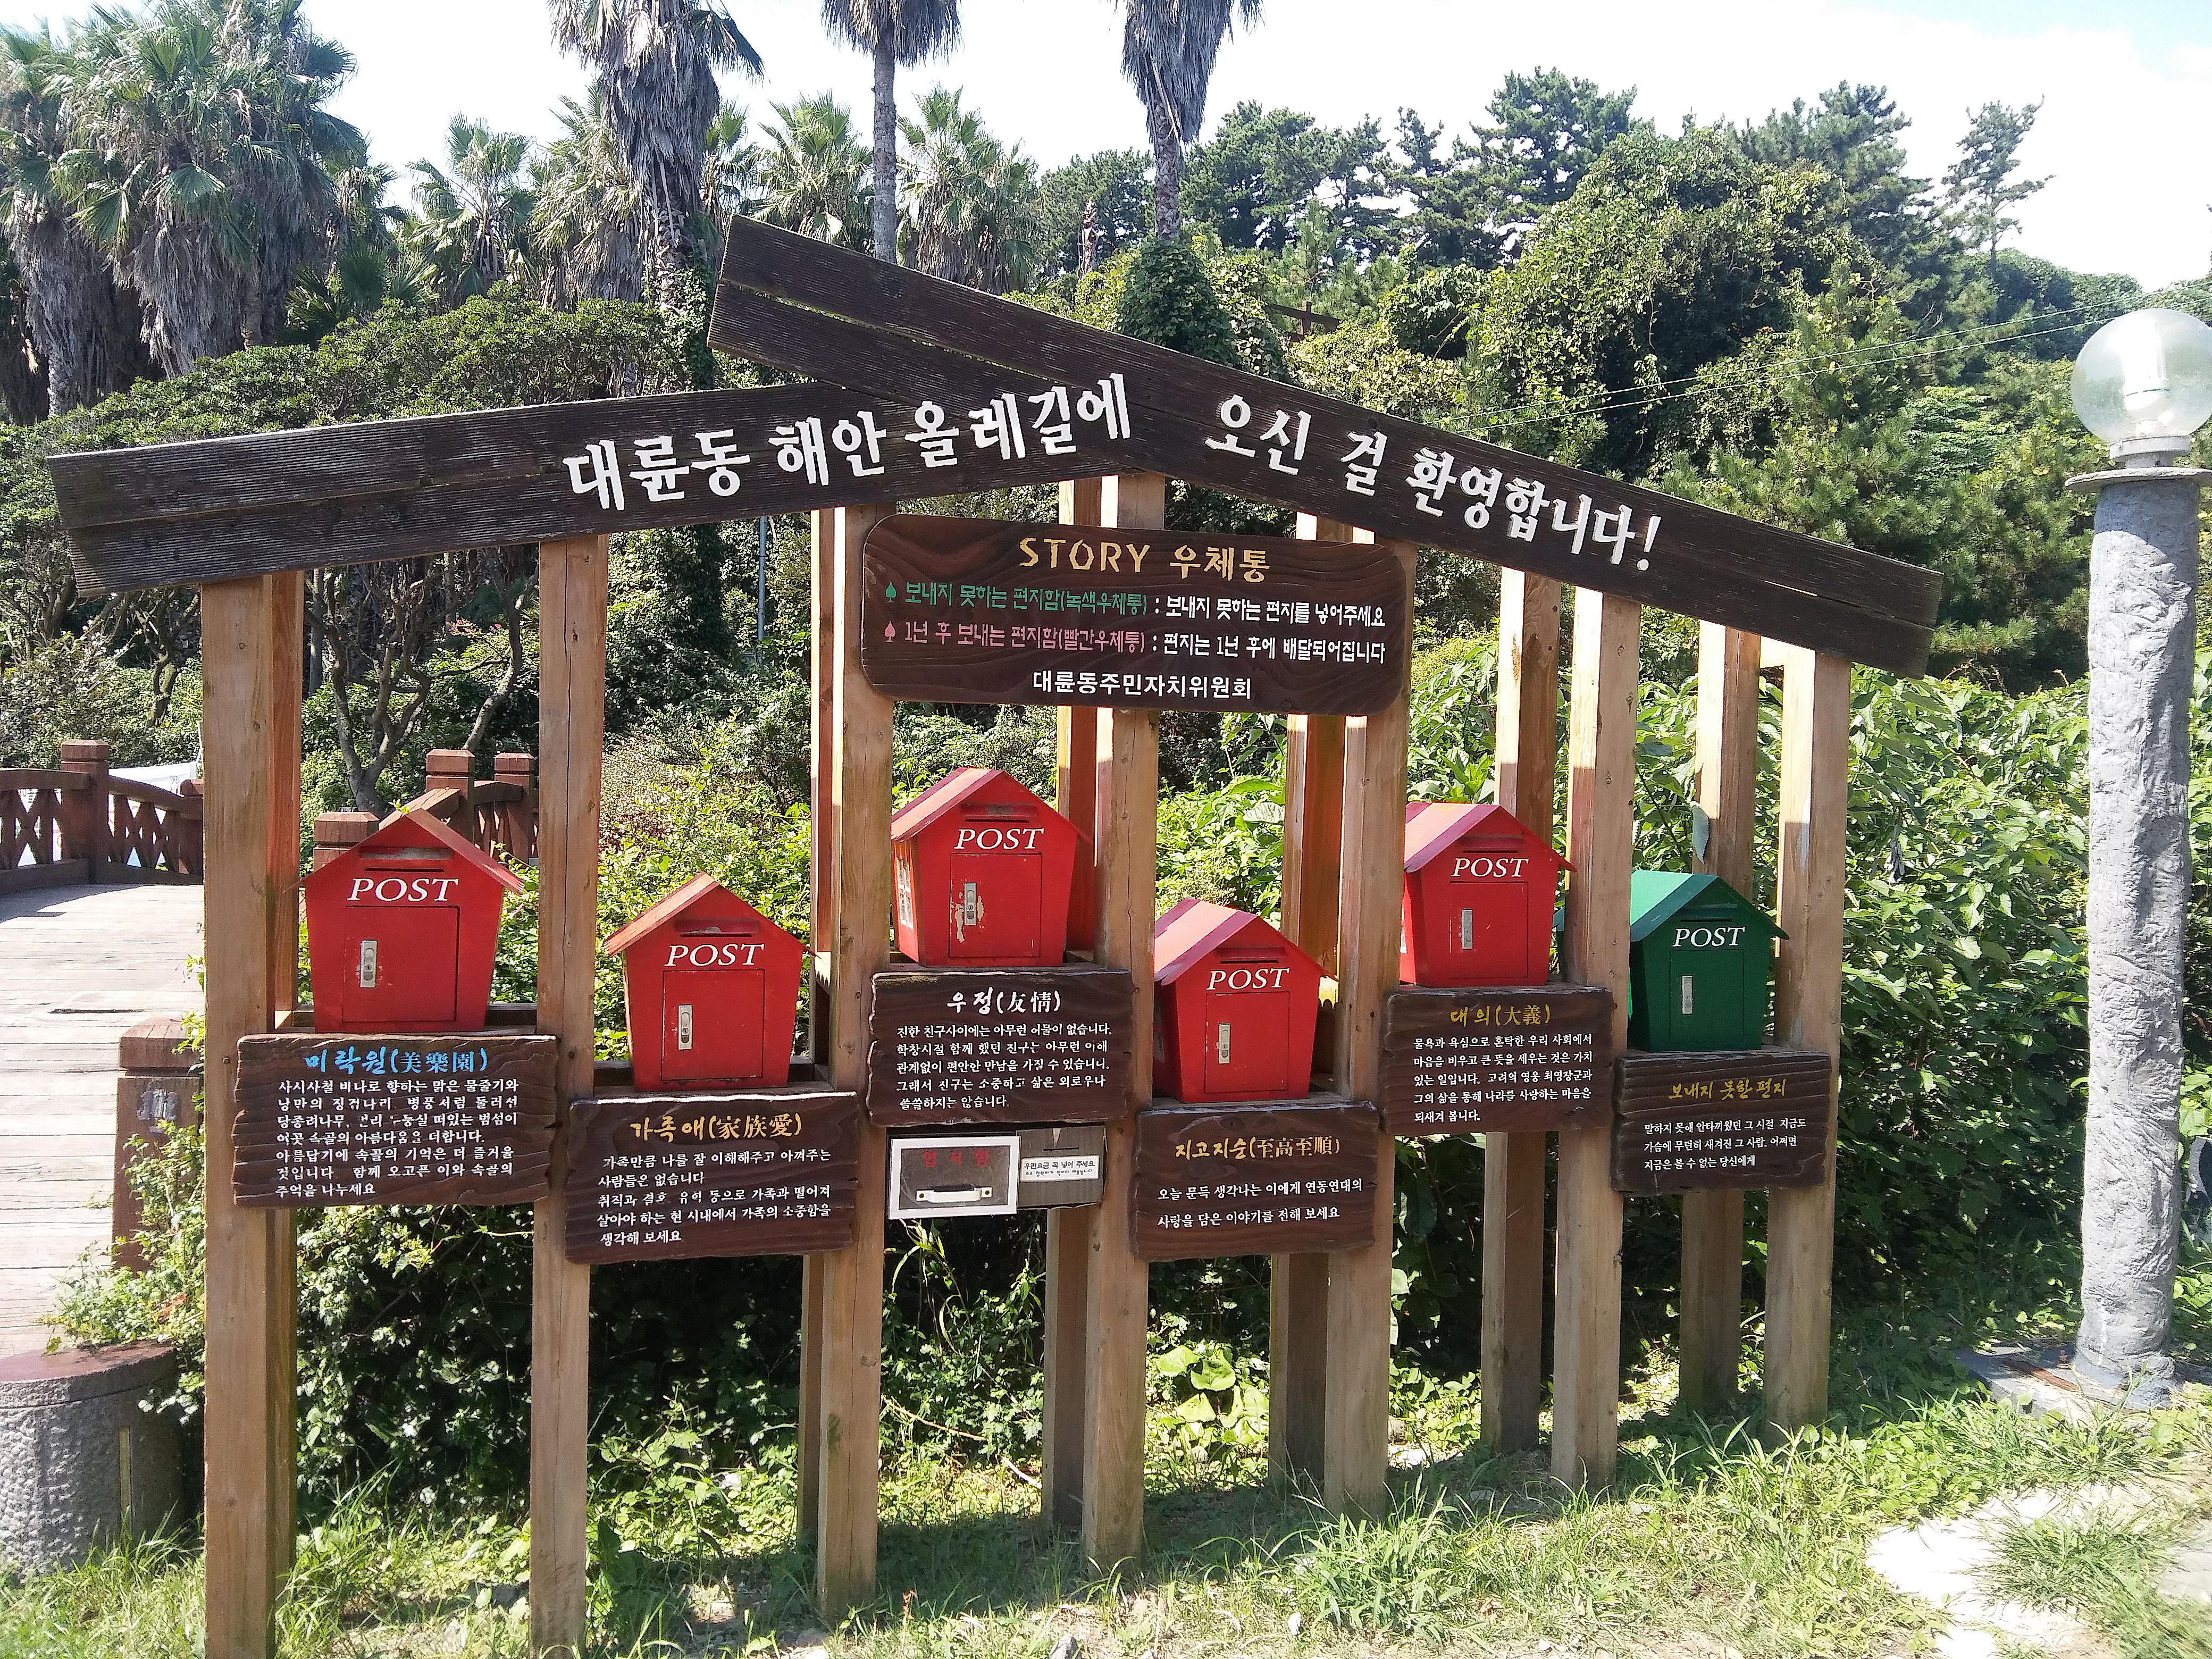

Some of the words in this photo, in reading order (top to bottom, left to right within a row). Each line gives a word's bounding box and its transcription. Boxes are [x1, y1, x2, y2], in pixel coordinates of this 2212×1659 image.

[563, 429, 750, 510] 대륜동
[768, 411, 886, 485] 해안
[903, 373, 1130, 467] 올레길에
[1205, 395, 1311, 475] 오신
[1340, 431, 1387, 496] 걸
[1405, 445, 1664, 574] 환영합니다!
[1020, 538, 1150, 573] STORY
[1170, 545, 1270, 582] 우체통
[906, 582, 952, 606] 보내지
[960, 585, 1007, 608] 못하는
[1014, 588, 1146, 615] 편지함(녹색우체통)
[1166, 596, 1210, 619] 보내지
[1217, 599, 1261, 621] 못하는
[1267, 601, 1310, 624] 편지를
[1316, 604, 1385, 627] 넣어주세요
[905, 621, 927, 643] 1년
[935, 622, 951, 644] 후
[958, 624, 1004, 647] 보내는
[1011, 626, 1144, 653] 편지함(빨간우체통)
[1164, 633, 1210, 656] 편지는
[1217, 636, 1238, 657] 1년
[1246, 636, 1275, 659] 후에
[1284, 638, 1385, 664] 배달되어집니다
[1034, 671, 1250, 699] 대륜동주민자치위원회
[954, 828, 1044, 849] POST
[1451, 858, 1529, 877] POST
[347, 878, 458, 901] POST
[1672, 927, 1745, 946] POST
[664, 944, 764, 966] POST
[1206, 968, 1289, 990] POST
[924, 1025, 990, 1037] 친구사이에는
[994, 1024, 1026, 1036] 아무런
[896, 1043, 944, 1056] 학창시절
[979, 1042, 1000, 1054] 했던
[1046, 1041, 1079, 1053] 아무런
[1413, 1037, 1445, 1049] 물욕과
[1448, 1037, 1490, 1048] 욕심으로
[1494, 1035, 1524, 1047] 혼탁한
[1528, 1035, 1547, 1046] 우리
[1553, 1034, 1591, 1045] 사회에서
[896, 1061, 941, 1074] 관계없이
[1023, 1059, 1043, 1071] 가질
[1048, 1059, 1059, 1070] 수
[1414, 1056, 1444, 1068] 마음을
[1448, 1055, 1478, 1067] 비우고
[1481, 1055, 1491, 1065] 큰
[1494, 1054, 1514, 1065] 뜻을
[1518, 1053, 1547, 1064] 세우는
[1551, 1052, 1570, 1063] 것은
[1574, 1051, 1591, 1062] 가치
[896, 1079, 931, 1092] 그래서
[1031, 1076, 1054, 1088] 삶은
[1414, 1075, 1434, 1086] 있는
[1521, 1071, 1540, 1082] 영웅
[1544, 1069, 1593, 1082] 최영장군과
[279, 1080, 333, 1094] 사시사철
[387, 1080, 428, 1093] 향하는
[464, 1079, 518, 1092] 물줄기와
[1414, 1093, 1433, 1103] 그의
[1437, 1092, 1459, 1103] 삶을
[1461, 1091, 1481, 1103] 통해
[1485, 1090, 1515, 1102] 나라를
[1520, 1088, 1559, 1101] 사랑하는
[1562, 1087, 1591, 1099] 마음을
[1669, 1082, 1713, 1099] 보내지
[1720, 1079, 1753, 1100] 못한
[1756, 1078, 1786, 1098] 편지
[479, 1112, 516, 1126] 범섬이
[1414, 1111, 1444, 1123] 되새겨
[1448, 1109, 1480, 1122] 봅니다.
[1645, 1122, 1671, 1134] 말하지
[1756, 1119, 1773, 1129] 시절
[1780, 1118, 1806, 1129] 지금도
[1644, 1141, 1671, 1152] 가슴에
[1771, 1135, 1796, 1146] 어쩌면
[276, 1149, 348, 1163] 아름답기에
[405, 1147, 446, 1160] 기억은
[454, 1147, 465, 1160] 더
[474, 1146, 514, 1159] 즐거울
[604, 1155, 657, 1169] 가족만큼
[662, 1154, 688, 1167] 나를
[693, 1153, 706, 1166] 잘
[711, 1151, 774, 1165] 이해해주고
[781, 1149, 831, 1162] 아껴주는
[1645, 1159, 1672, 1171] 지금은
[1674, 1159, 1684, 1169] 볼
[1686, 1158, 1696, 1169] 수
[1699, 1157, 1716, 1168] 없는
[1720, 1155, 1755, 1167] 당신에게
[438, 1163, 465, 1176] 이와
[655, 1171, 705, 1186] 없습니다
[322, 1183, 375, 1196] 나누세요
[598, 1194, 638, 1208] 취직과
[752, 1186, 790, 1201] 가족과
[794, 1185, 830, 1199] 떨어져
[1158, 1188, 1182, 1200] 오늘
[1186, 1186, 1210, 1199] 문득
[1214, 1184, 1262, 1198] 생각나는
[1266, 1181, 1300, 1195] 이에게
[1305, 1178, 1361, 1193] 연동연대의
[597, 1212, 636, 1227] 살아야
[640, 1212, 666, 1225] 하는
[671, 1210, 682, 1223] 현
[742, 1206, 777, 1219] 가족의
[783, 1203, 831, 1218] 소중함을
[1158, 1214, 1194, 1228] 사랑을
[1198, 1213, 1222, 1226] 담은
[1226, 1210, 1273, 1225] 이야기를
[1278, 1208, 1300, 1221] 전해
[1305, 1206, 1340, 1219] 보세요
[600, 1231, 639, 1246] 생각해
[643, 1230, 681, 1243] 보세요
